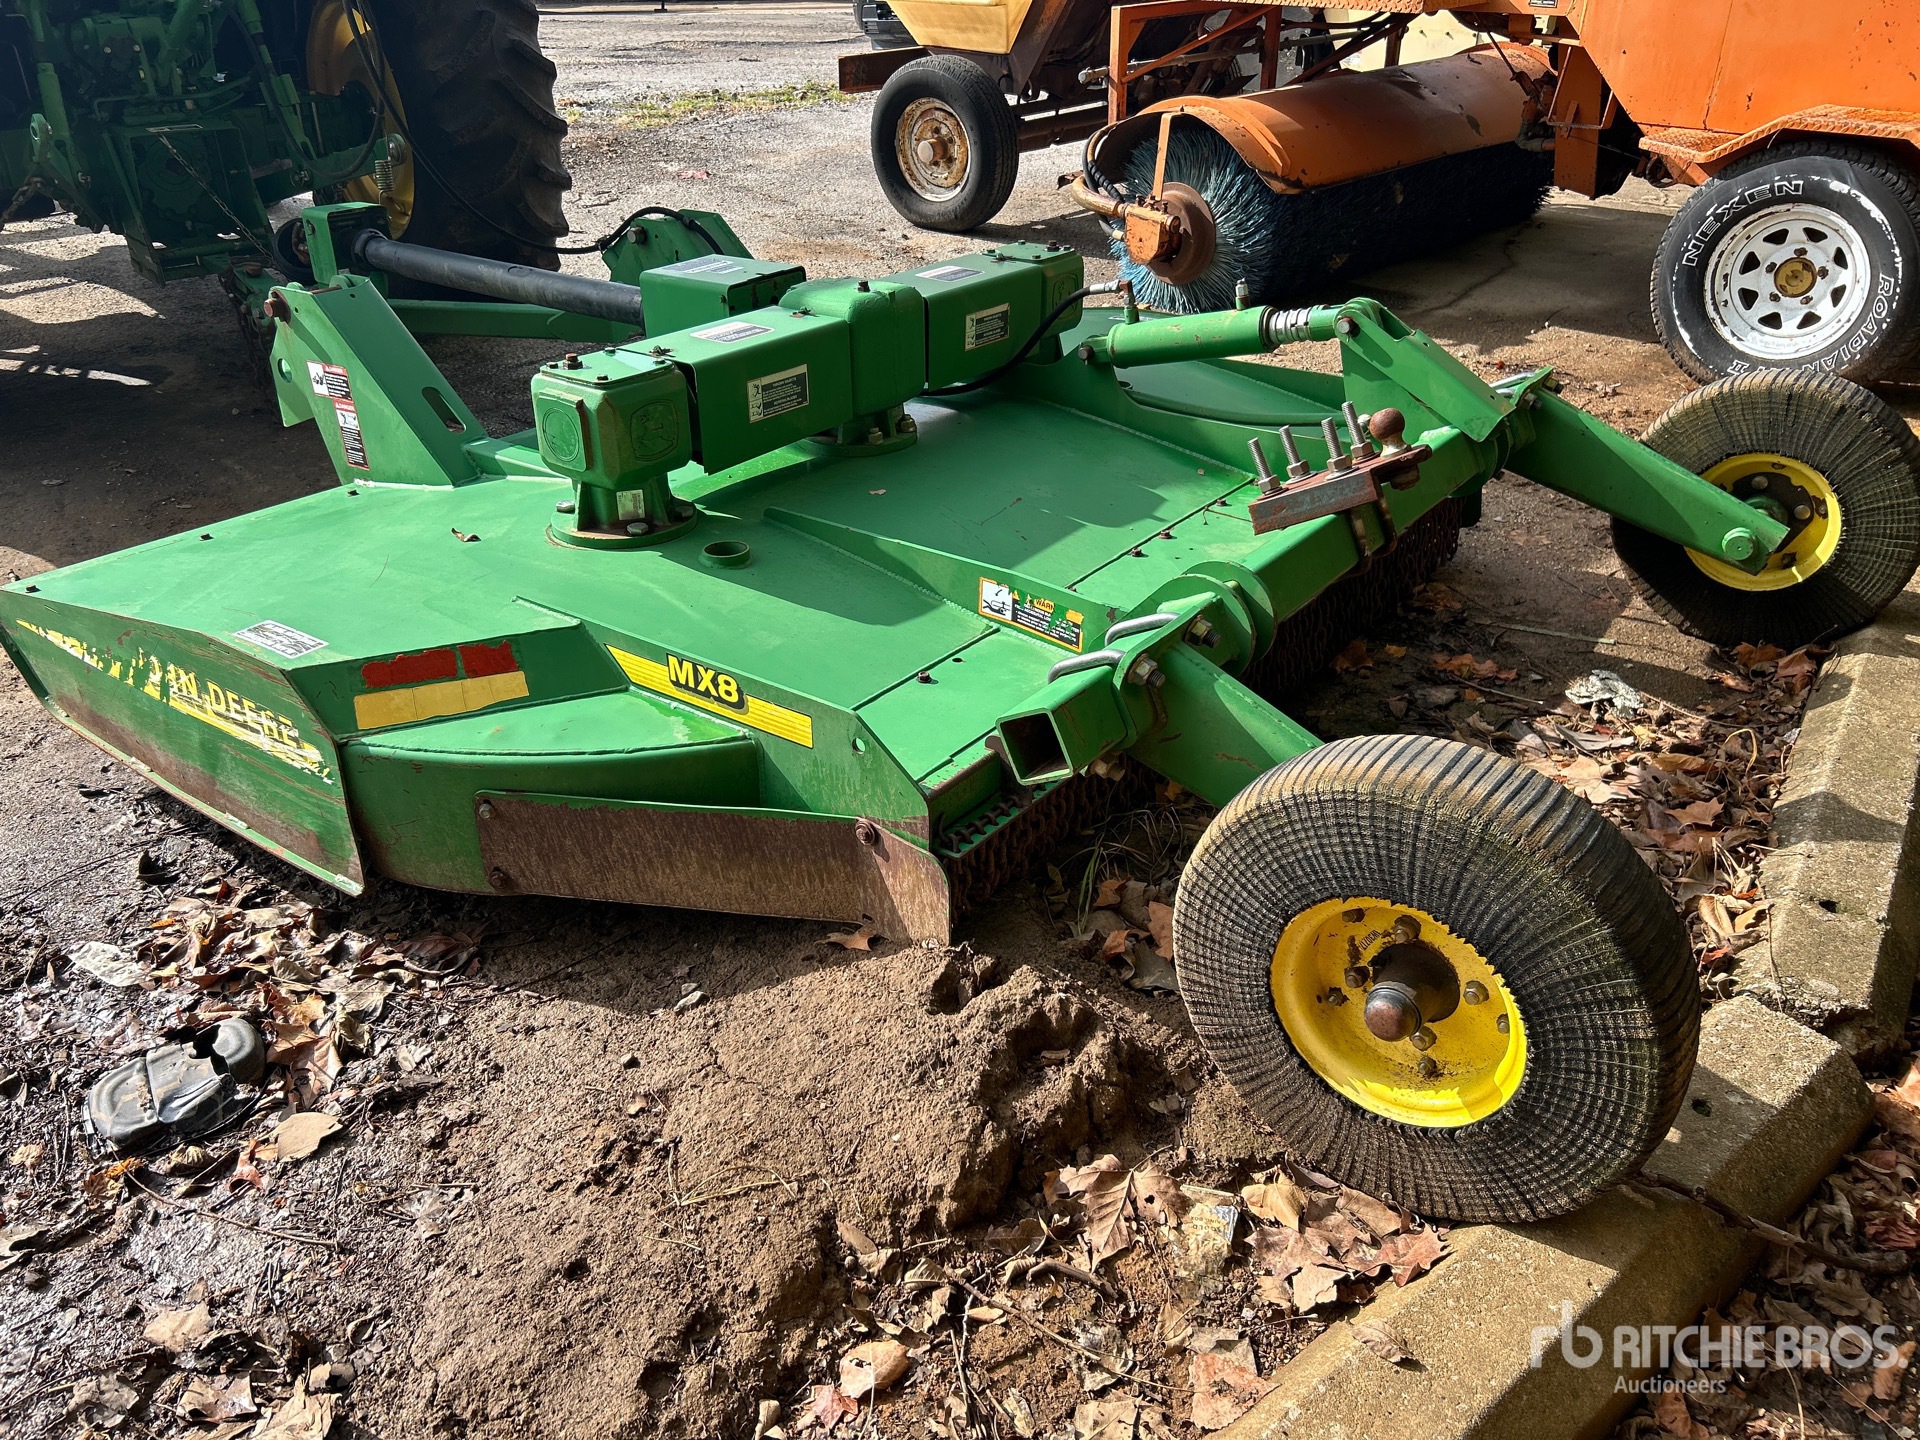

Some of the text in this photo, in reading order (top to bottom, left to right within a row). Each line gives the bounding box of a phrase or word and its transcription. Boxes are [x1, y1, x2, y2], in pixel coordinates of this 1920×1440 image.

[1681, 180, 1804, 267] NEXEN
[1802, 272, 1894, 372] ROADIAN
[206, 679, 298, 748] DEERE
[667, 653, 742, 706] MX8
